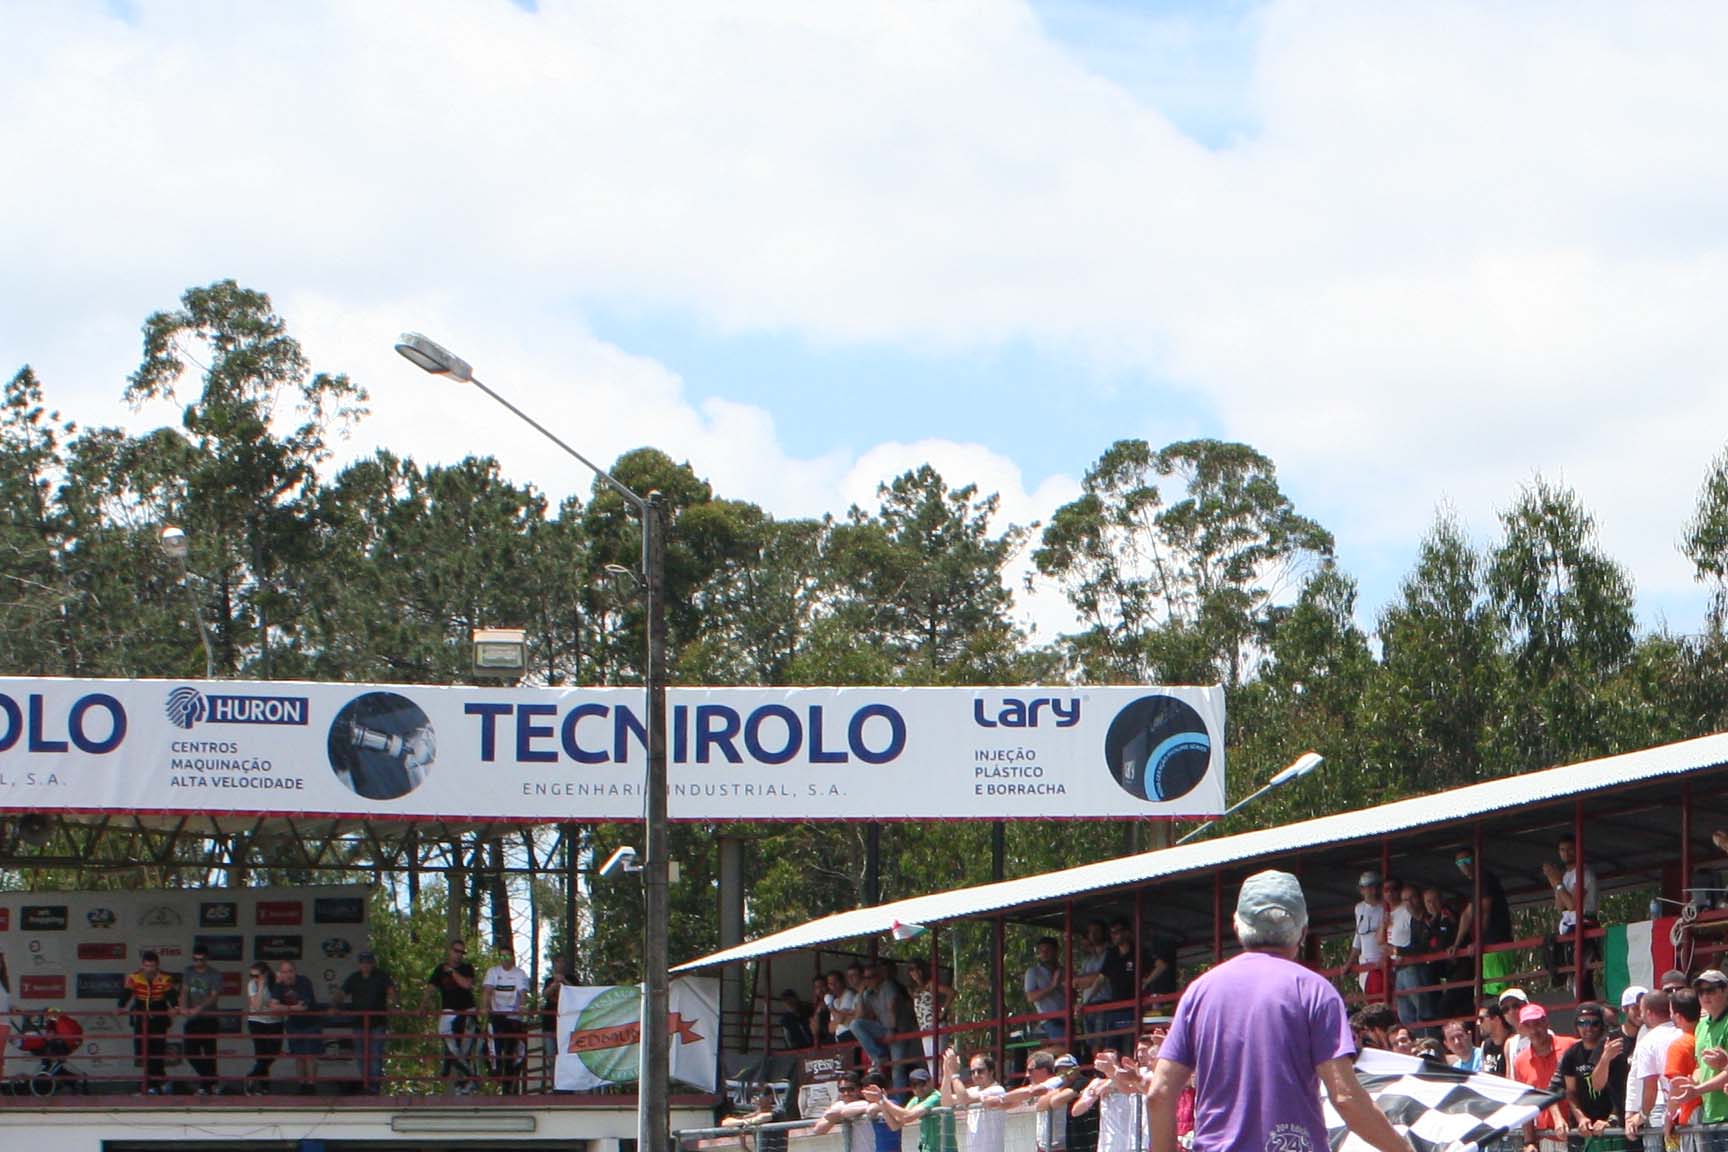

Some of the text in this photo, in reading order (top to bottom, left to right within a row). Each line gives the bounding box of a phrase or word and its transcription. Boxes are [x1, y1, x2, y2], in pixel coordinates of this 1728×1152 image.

[217, 699, 301, 721] HURON
[463, 703, 907, 765] TECNIROLO
[171, 741, 238, 755] CENTROS
[975, 747, 1037, 764] INJEÇÃO
[170, 757, 272, 774] MAQUINAÇÃO
[975, 765, 1044, 778] PLÁSTICO
[170, 776, 304, 790] ALTA VELOCIDADE
[522, 782, 646, 797] ENGENHARI
[808, 783, 848, 798] S.A.
[975, 784, 1067, 796] E BORRACHA
